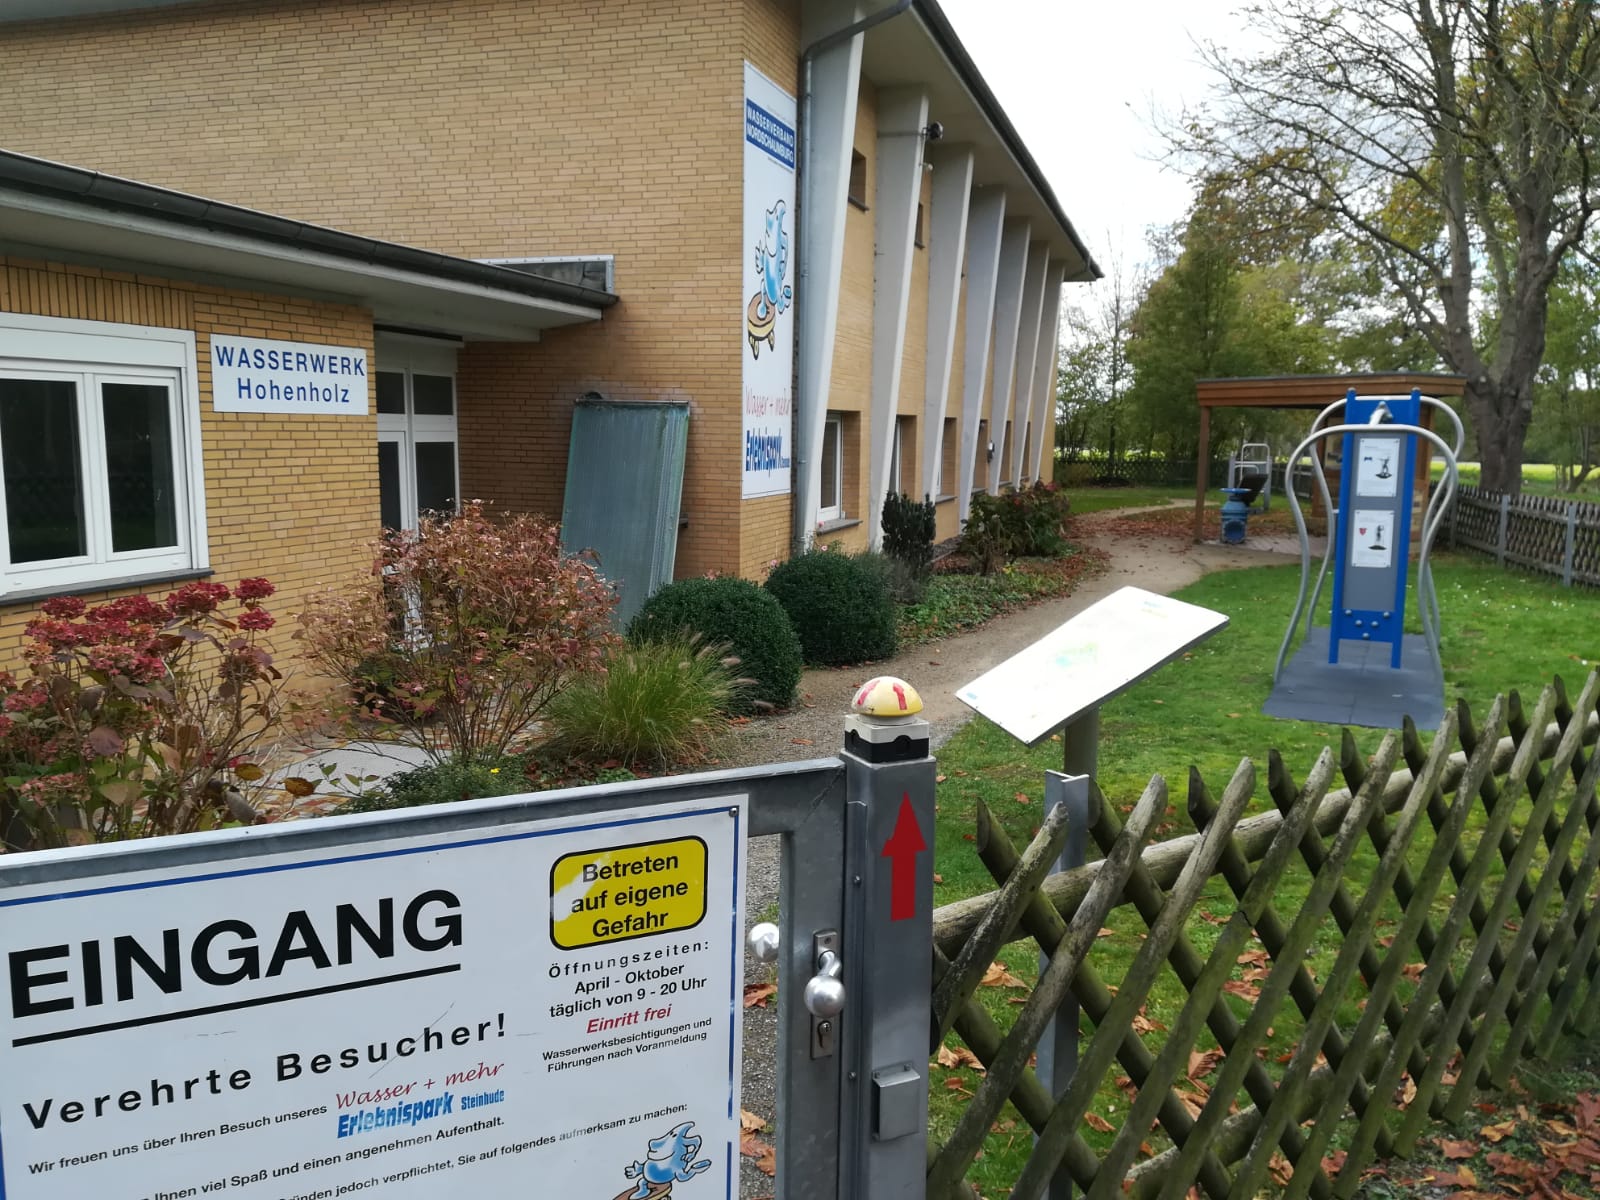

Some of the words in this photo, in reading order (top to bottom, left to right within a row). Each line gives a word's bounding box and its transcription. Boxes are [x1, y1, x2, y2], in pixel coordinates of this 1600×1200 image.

[215, 345, 365, 376] WASSERWERK
[238, 377, 349, 403] Hohenholz
[582, 855, 678, 883] Betreten
[571, 890, 608, 913] auf
[615, 881, 689, 907] eigene
[592, 911, 669, 937] Gefahr
[8, 889, 463, 1018] EINGANG
[548, 941, 709, 978] Öffnungszeiten:
[549, 998, 601, 1018] täglich
[606, 992, 633, 1006] von
[637, 988, 646, 1000] 9
[660, 982, 677, 996] 20
[681, 977, 707, 991] Uhr
[574, 977, 610, 994] April
[625, 964, 685, 984] Oktober
[542, 1021, 691, 1060] Wasserwerksbesichtigungen
[693, 1017, 712, 1028] und
[586, 1011, 639, 1033] Einritt
[644, 1003, 672, 1022] frei
[22, 1067, 252, 1129] Verehrte
[277, 1012, 505, 1081] Besucher!
[547, 1054, 605, 1073] Führungen
[607, 1047, 633, 1060] nach
[635, 1031, 707, 1053] Voranmeldung
[336, 1081, 417, 1109] Wasser
[424, 1078, 436, 1090] +
[445, 1062, 505, 1087] mehr
[337, 1091, 454, 1139] Erlebnispark
[461, 1089, 505, 1110] Steinhude
[28, 1162, 55, 1174] Wir
[59, 1150, 108, 1168] freuen
[112, 1144, 139, 1157] uns
[143, 1136, 176, 1150] über
[180, 1128, 216, 1143] Ihren
[220, 1116, 271, 1134] Besuch
[275, 1105, 328, 1123] unseres
[154, 1186, 197, 1200] Ihnen
[201, 1178, 227, 1193] viel
[231, 1169, 268, 1187] Spaß
[272, 1162, 299, 1177] und
[303, 1154, 341, 1170] einen
[345, 1134, 432, 1161] angenehmen
[436, 1116, 505, 1140] Aufenthalt.
[335, 1177, 379, 1197] jedoch
[382, 1159, 455, 1183] verpflichtet,
[457, 1154, 476, 1166] Sie
[480, 1147, 498, 1161] auf
[501, 1135, 556, 1156] folgendes
[559, 1117, 626, 1141] aufmerksam
[629, 1114, 641, 1124] zu
[644, 1103, 688, 1121] machen:
